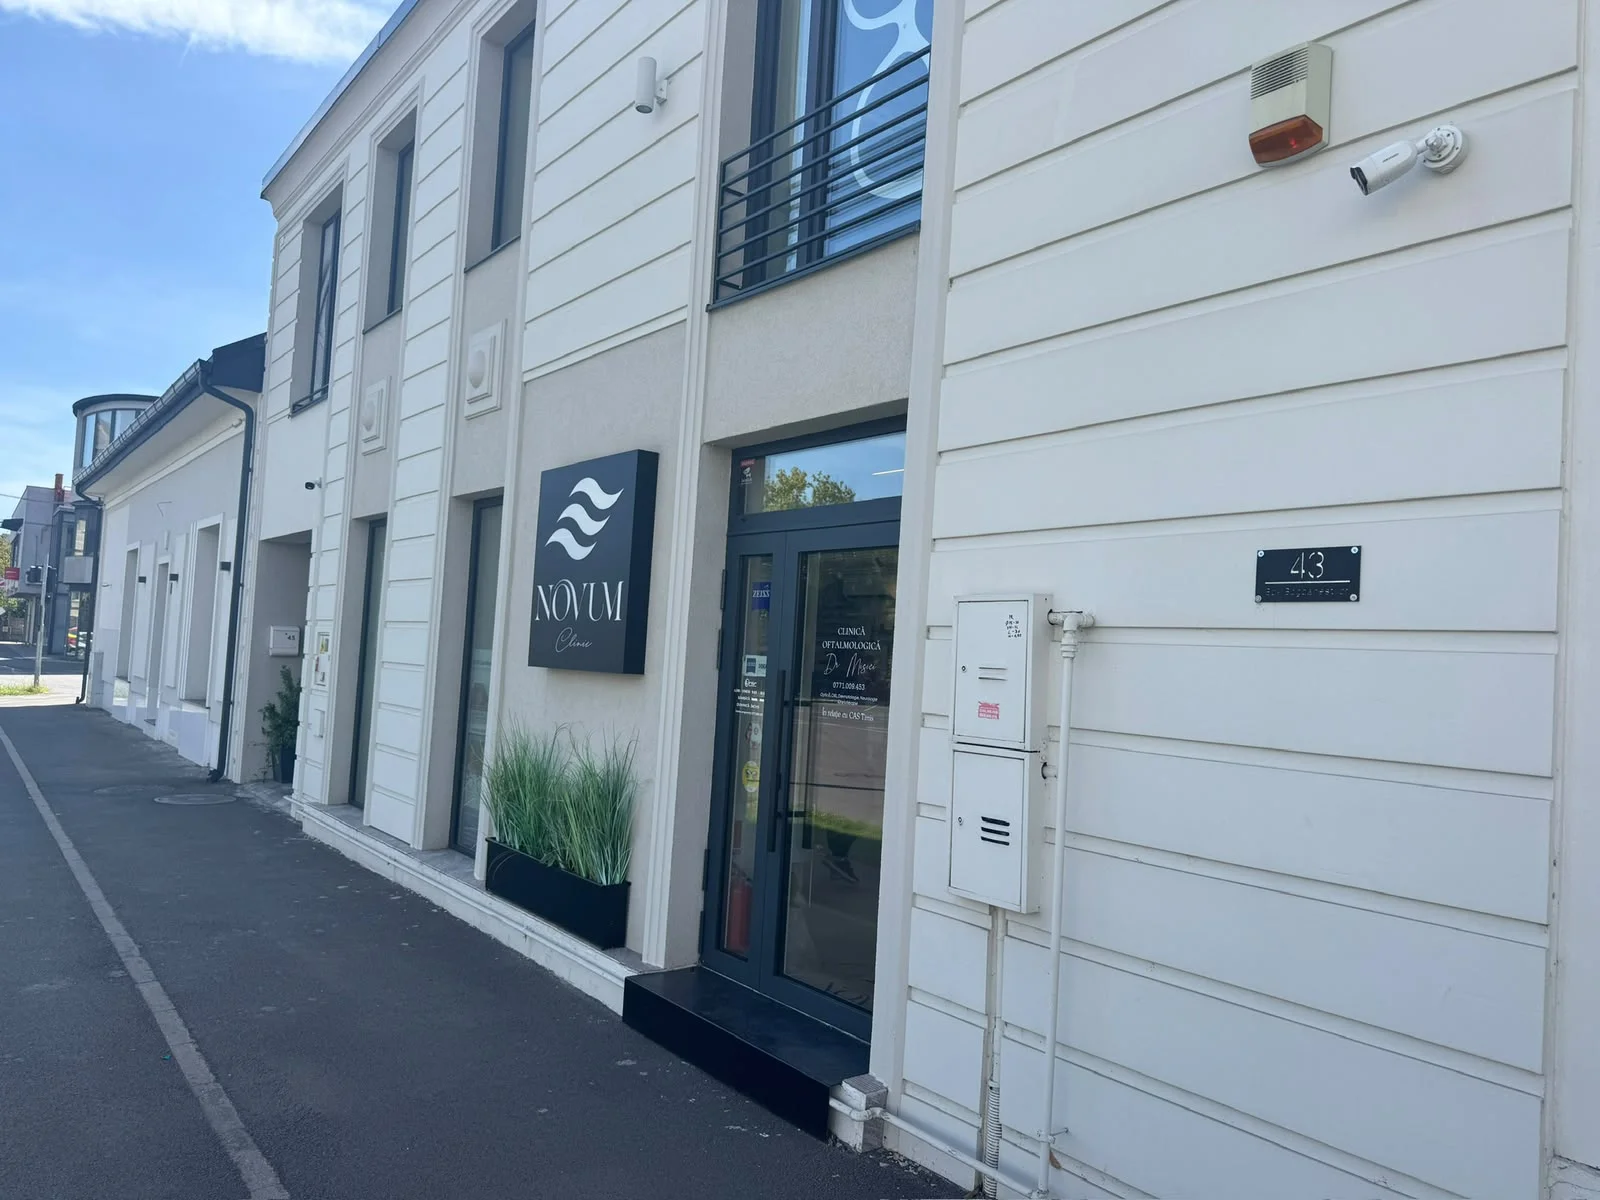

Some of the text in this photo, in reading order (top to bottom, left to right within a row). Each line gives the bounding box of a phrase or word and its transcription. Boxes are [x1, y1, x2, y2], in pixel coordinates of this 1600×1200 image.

[1290, 551, 1325, 579] 43
[752, 590, 770, 598] ZEISS
[534, 578, 625, 622] NOVUM
[837, 626, 866, 636] CLINICĂ
[555, 626, 593, 653] Clinic
[822, 640, 881, 651] OFTALMOLOGICĂ
[849, 711, 860, 720] CAS
